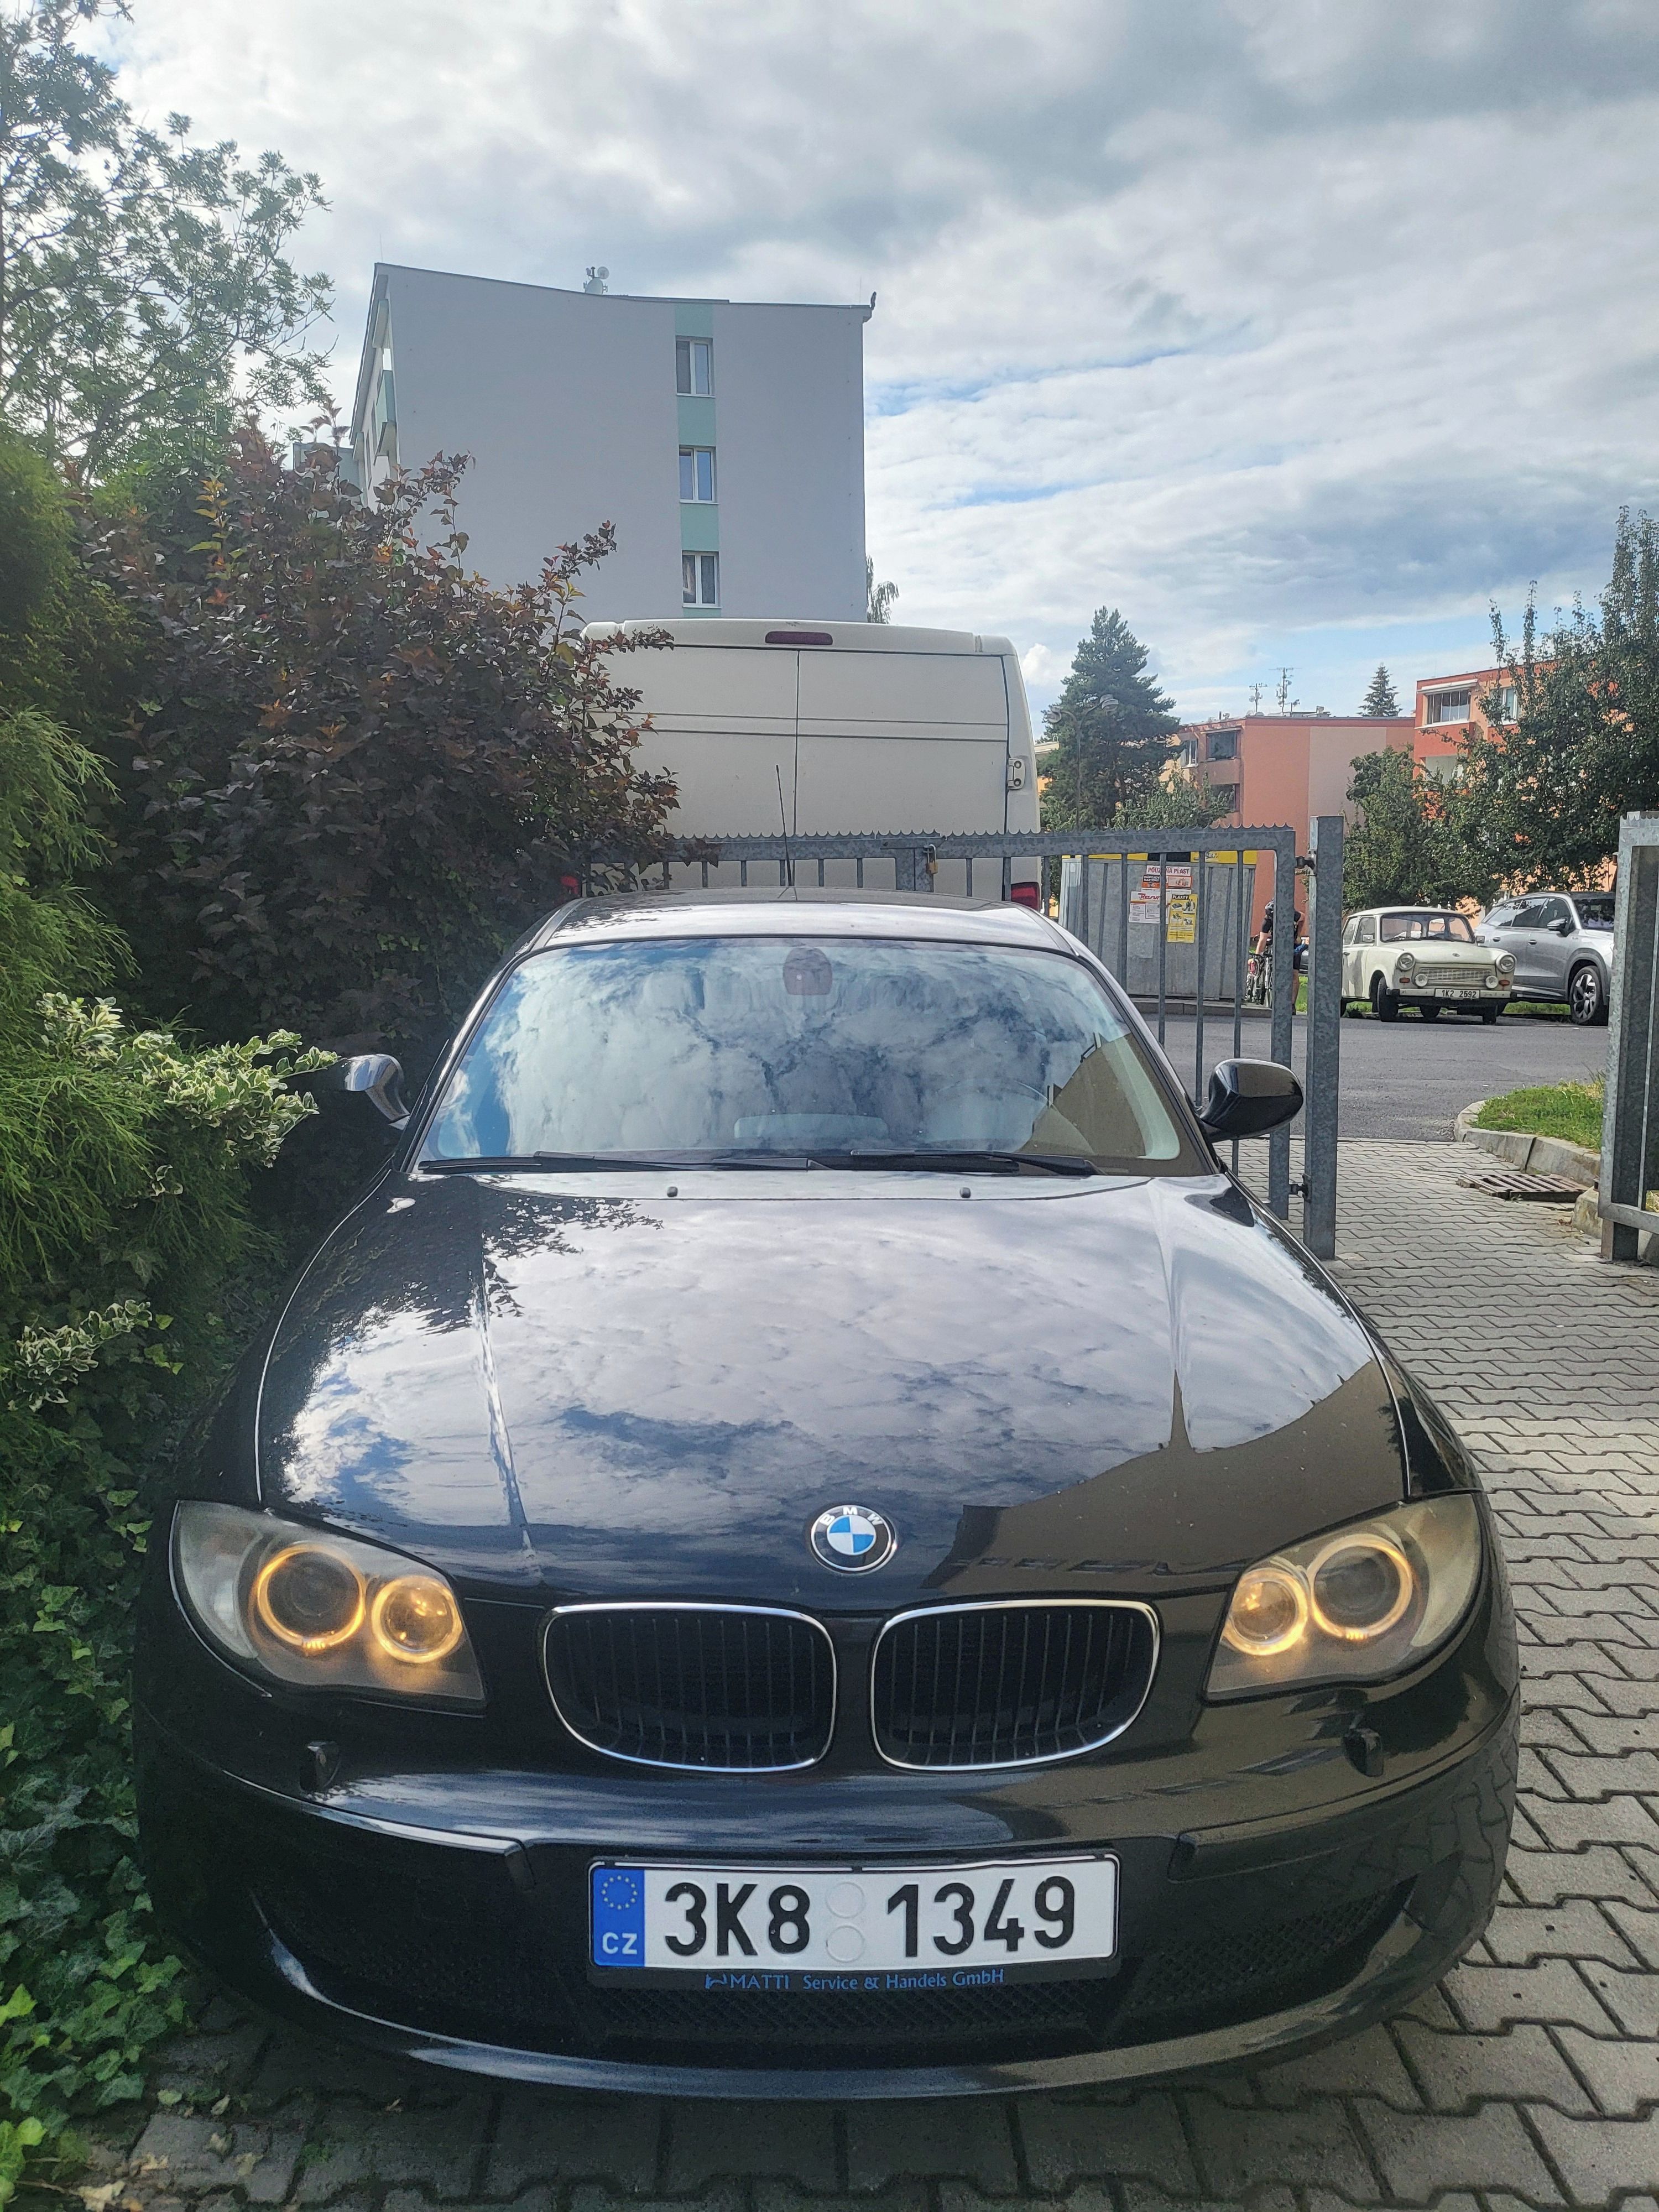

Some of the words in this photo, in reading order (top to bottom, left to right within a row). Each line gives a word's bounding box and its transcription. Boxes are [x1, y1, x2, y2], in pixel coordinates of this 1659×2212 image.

[819, 1507, 884, 1526] BMW
[665, 1881, 811, 1957] 3K8
[887, 1876, 1075, 1958] 1349
[602, 1932, 638, 1955] CZ
[730, 1974, 790, 1989] MATTI
[803, 1974, 857, 1990] Service
[864, 1975, 879, 1989] &
[886, 1972, 947, 1989] Handels
[952, 1968, 1004, 1985] GmbH
